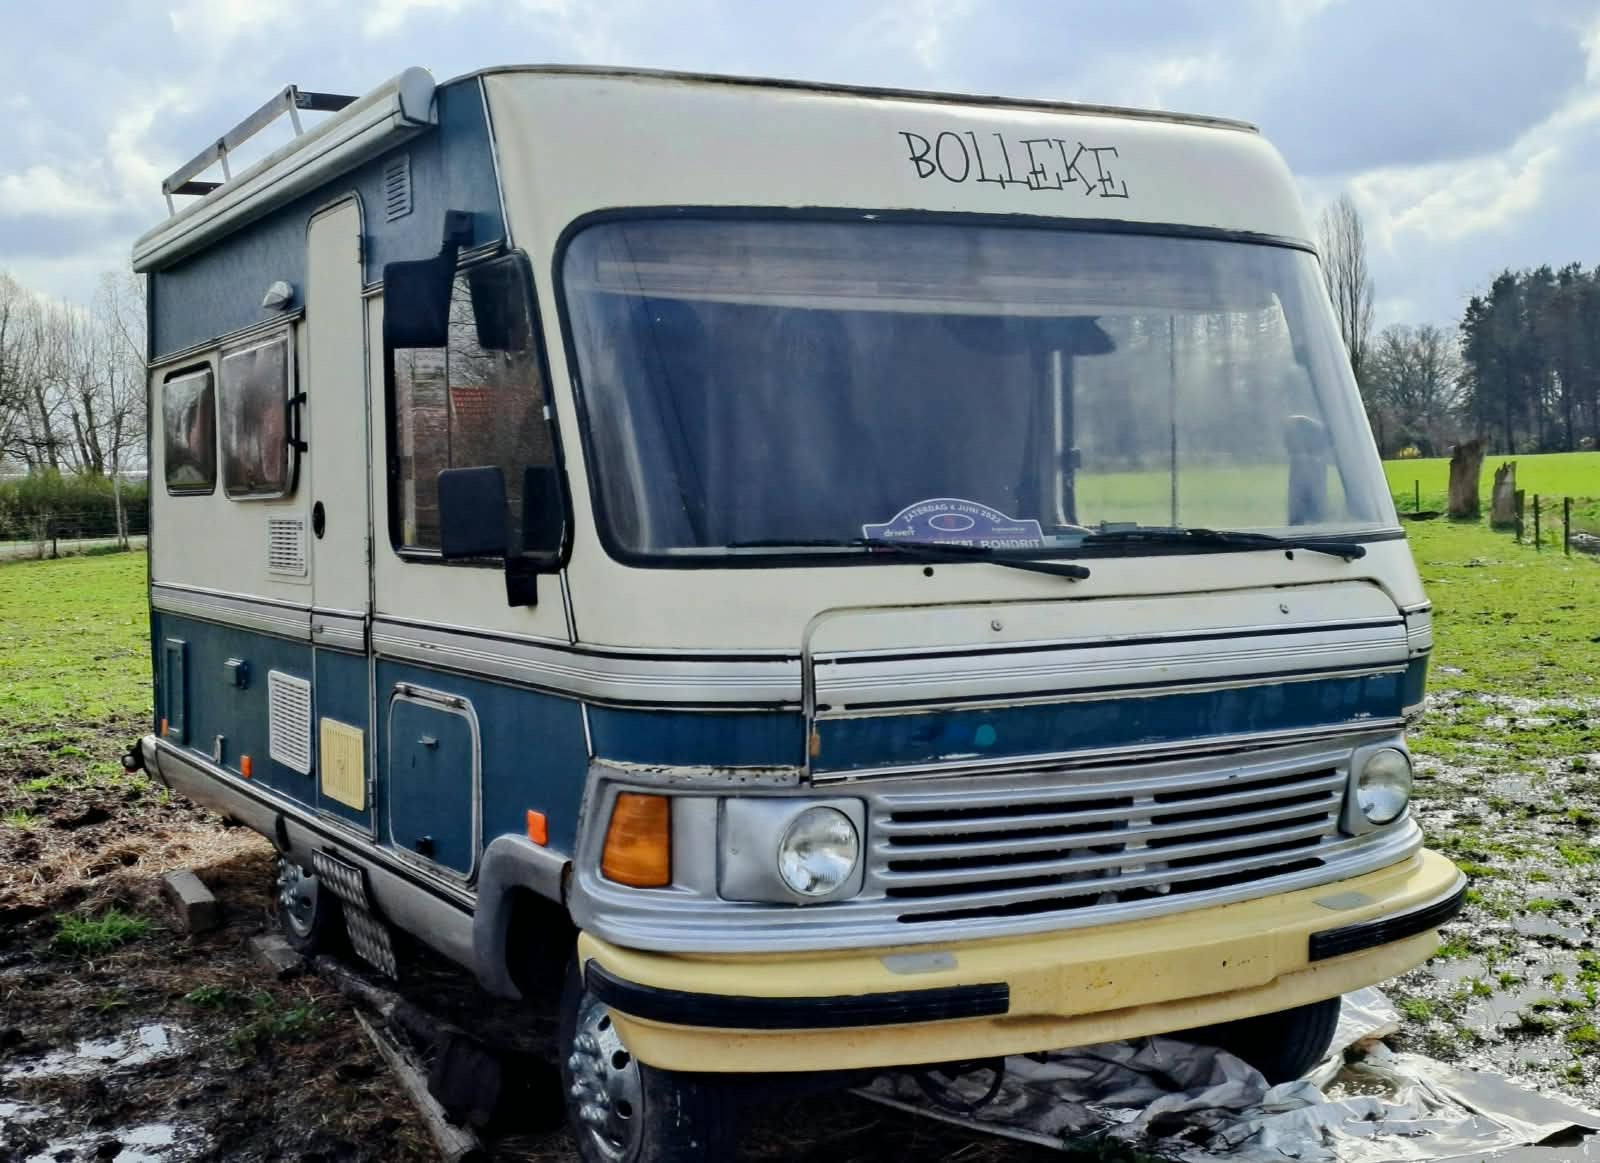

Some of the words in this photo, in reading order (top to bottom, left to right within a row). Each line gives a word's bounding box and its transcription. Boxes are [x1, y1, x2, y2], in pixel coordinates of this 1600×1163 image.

[898, 131, 1129, 198] BOLLEKE
[902, 504, 948, 522] ZATERDAG
[958, 504, 979, 514] JUNI
